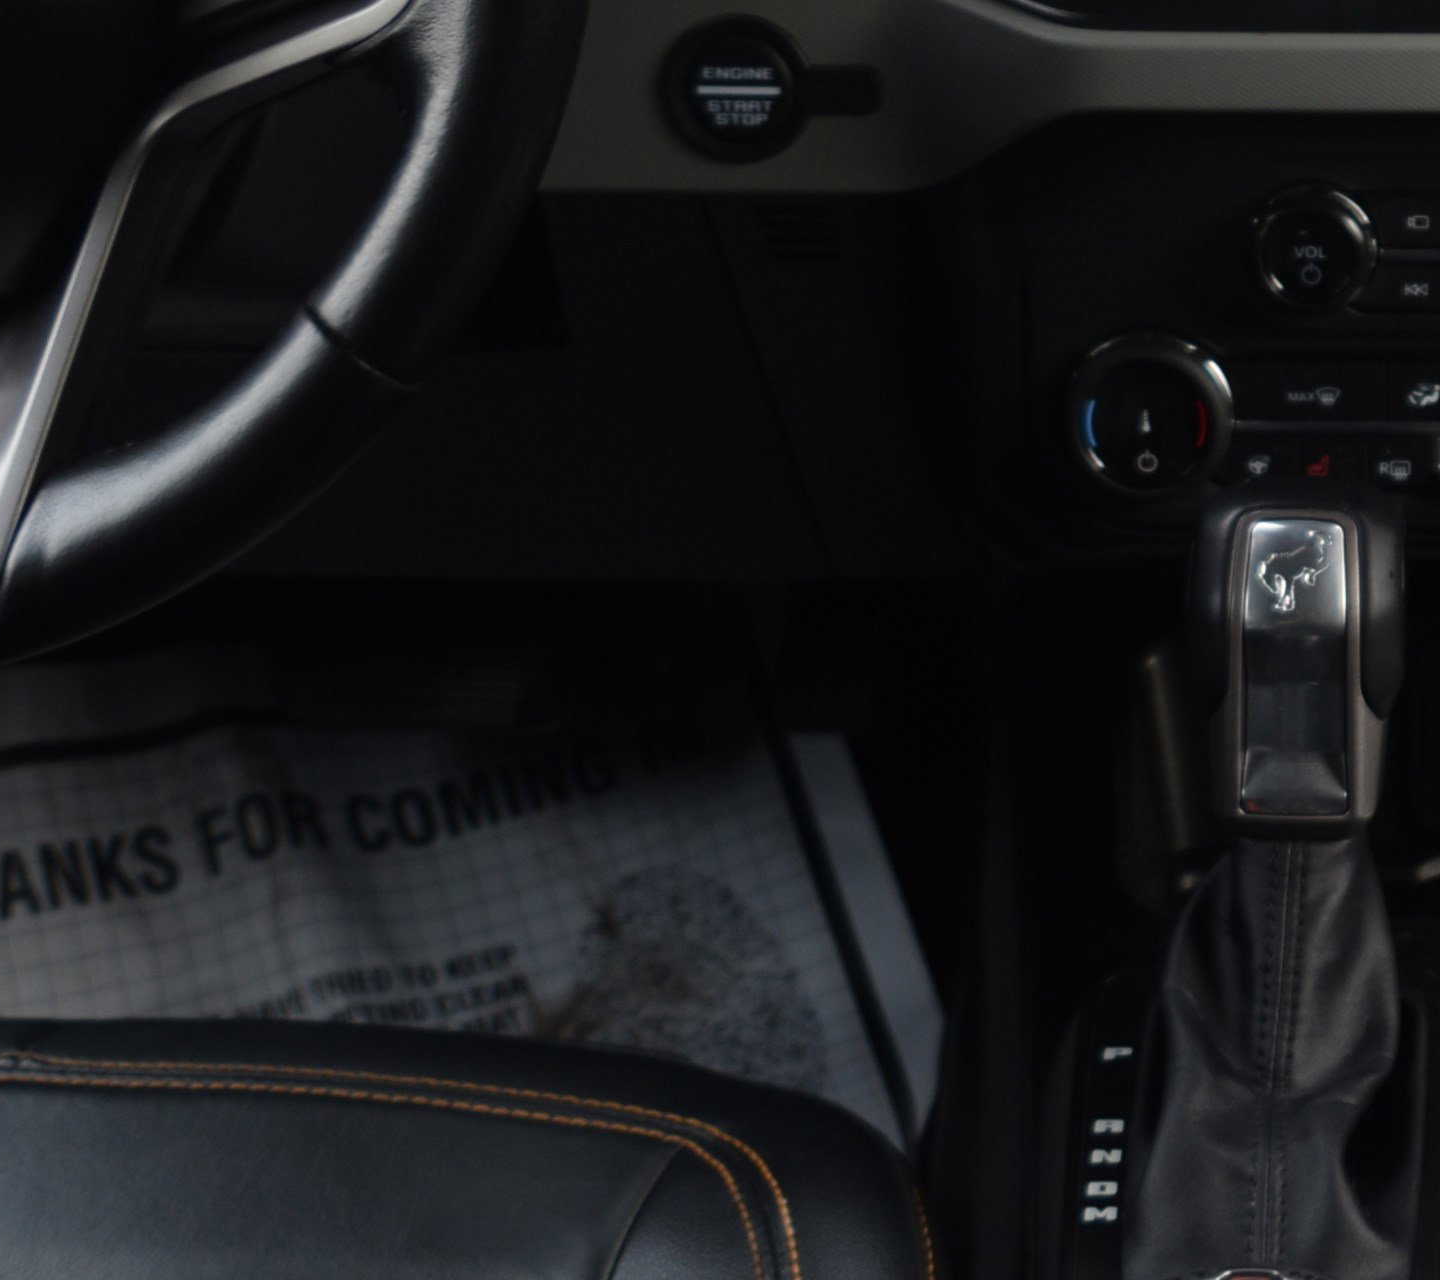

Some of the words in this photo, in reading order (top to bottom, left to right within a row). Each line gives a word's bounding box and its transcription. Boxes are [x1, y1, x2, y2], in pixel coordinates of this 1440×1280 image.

[702, 67, 774, 80] ENGINE
[706, 99, 773, 112] START
[715, 113, 768, 126] STOP
[1294, 245, 1326, 260] VOL
[1287, 392, 1314, 401] MAX
[194, 786, 327, 877] FOR
[344, 736, 620, 854] COMING
[1102, 1046, 1134, 1061] P
[1089, 1148, 1123, 1164] N
[1086, 1180, 1119, 1196] D
[1082, 1206, 1119, 1222] M
